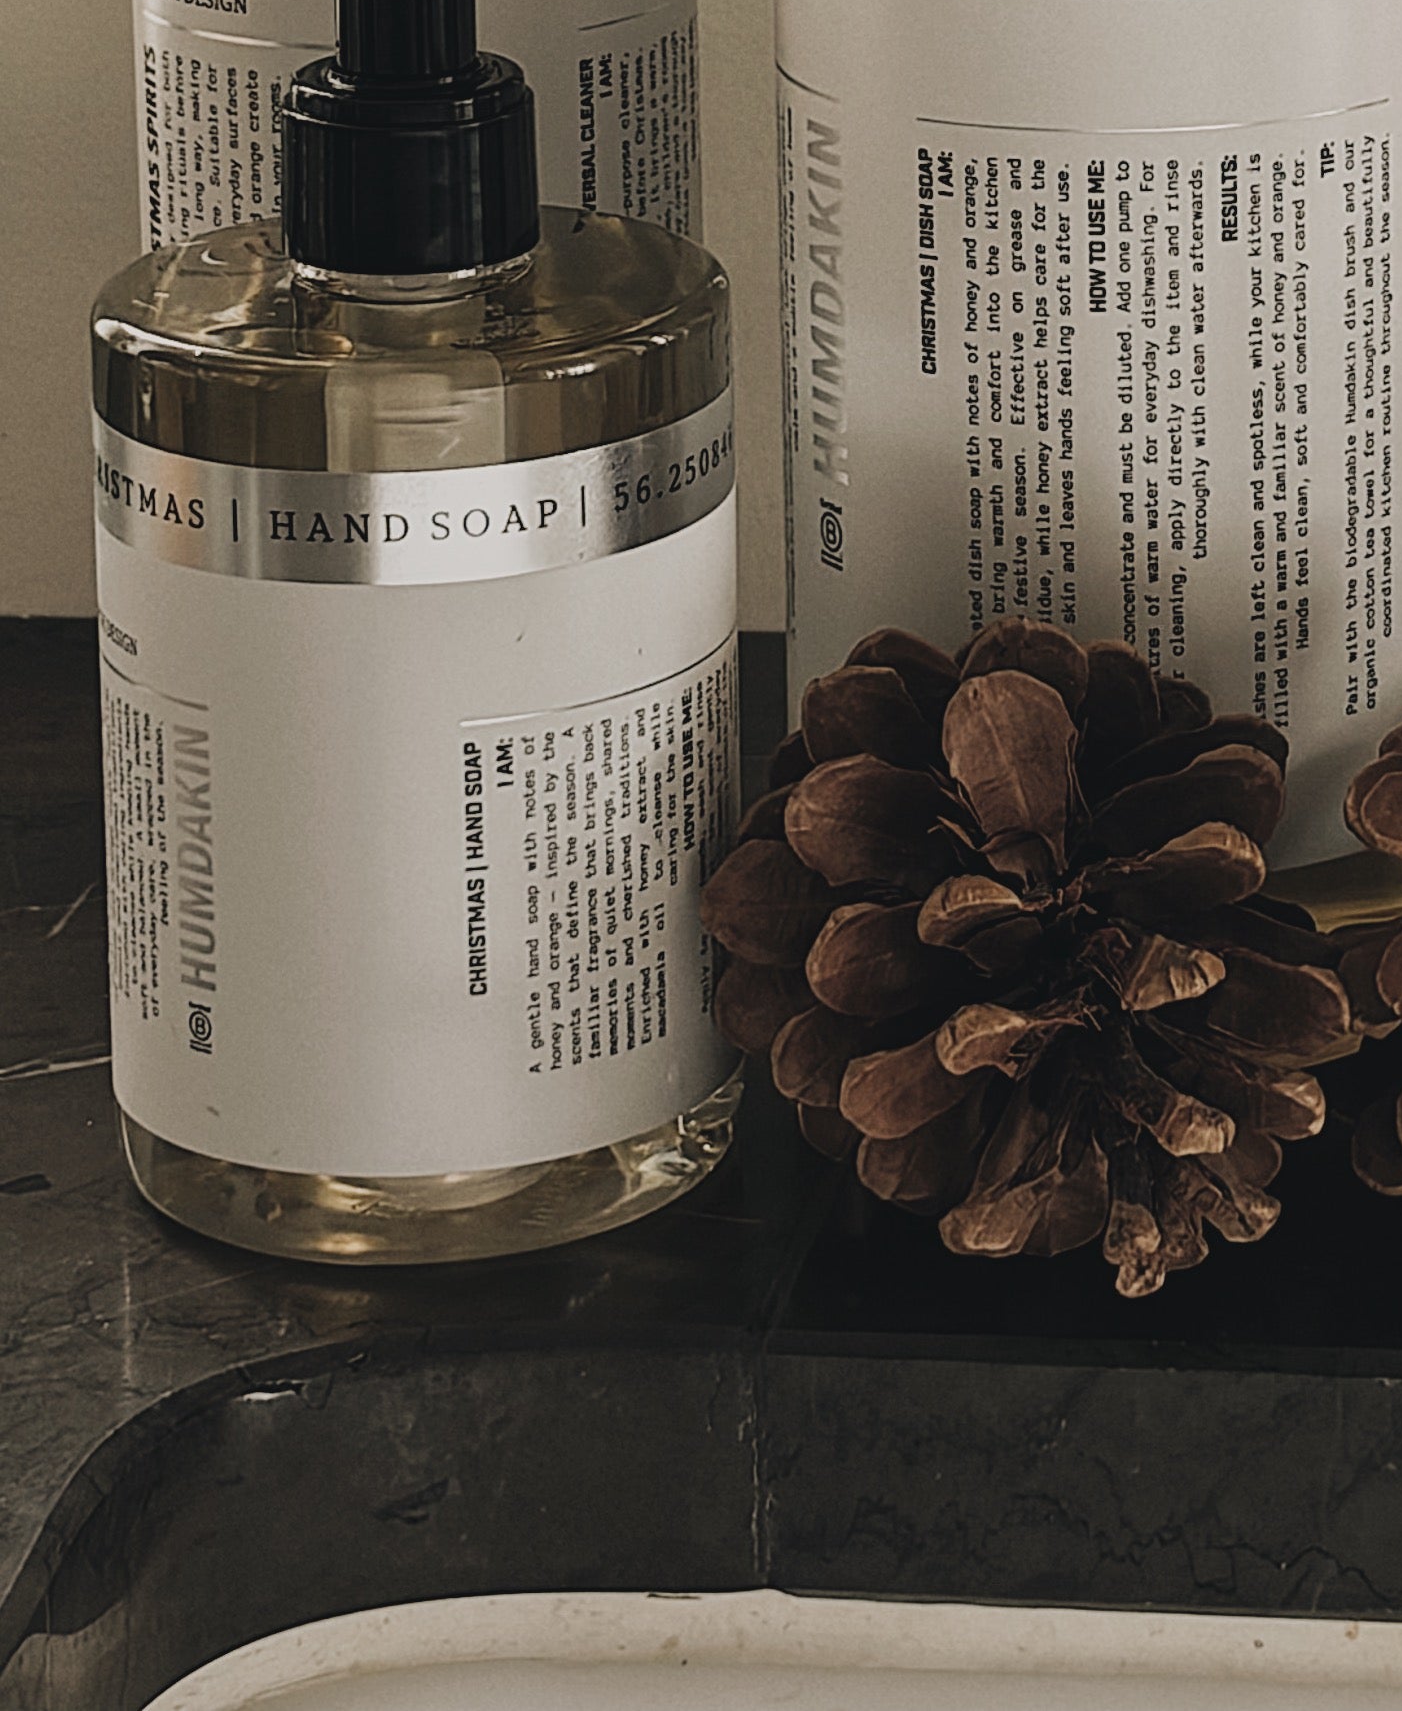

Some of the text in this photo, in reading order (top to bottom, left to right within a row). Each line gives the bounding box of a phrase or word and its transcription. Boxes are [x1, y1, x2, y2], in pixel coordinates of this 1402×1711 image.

[142, 44, 159, 157] SPIRITS
[205, 63, 221, 188] Suitable for
[578, 57, 595, 143] CLEANER
[597, 53, 613, 99] I AM:
[225, 67, 247, 226] veryday surfaces
[244, 69, 264, 205] orange create
[936, 151, 954, 198] I AM:
[1319, 141, 1335, 179] TIP:
[964, 158, 979, 229] orange,
[1086, 159, 1107, 313] HOW TO USE ME:
[1220, 154, 1238, 243] RESULTS:
[806, 118, 851, 489] HUMDAKIN
[917, 147, 937, 376] CHRISTMAS DISH SOAP
[961, 237, 977, 271] and
[963, 280, 981, 333] honey
[963, 341, 979, 365] of
[965, 374, 980, 427] notes
[983, 157, 1009, 615] bring warmth and comfort into the kitchen
[1005, 158, 1029, 607] festive season. Effective on grease and
[1054, 163, 1076, 626] skin and leaves hands feeling soft after use.
[1114, 160, 1136, 647] concentrate and must be diluted. Add one pump to
[1187, 161, 1211, 561] thoroughly with clean water afterwards.
[1291, 150, 1311, 651] Hands feel clean, soft and comfortably cared for.
[965, 435, 981, 479] with
[1269, 153, 1289, 729] filled with a warm and familiar scent of honey and orange.
[1341, 139, 1360, 717] Pair with the biodegradable Humdakin dish brush and our
[268, 509, 410, 543] HAND
[429, 498, 560, 540] SOAP
[969, 487, 984, 531] soap
[967, 539, 983, 583] dish
[495, 737, 514, 789] I AM:
[560, 726, 574, 739] A
[680, 686, 696, 852] HOW TO USE ME:
[173, 723, 217, 993] HUMDAKIN
[462, 742, 488, 997] CHRISTMAS HAND SOAP
[541, 732, 565, 1072] honey and orange inspired by the
[565, 836, 578, 867] the
[519, 736, 545, 1074] A gentle hand soap with notes of
[565, 880, 580, 940] define
[566, 953, 580, 994] that
[568, 1007, 583, 1066] scents
